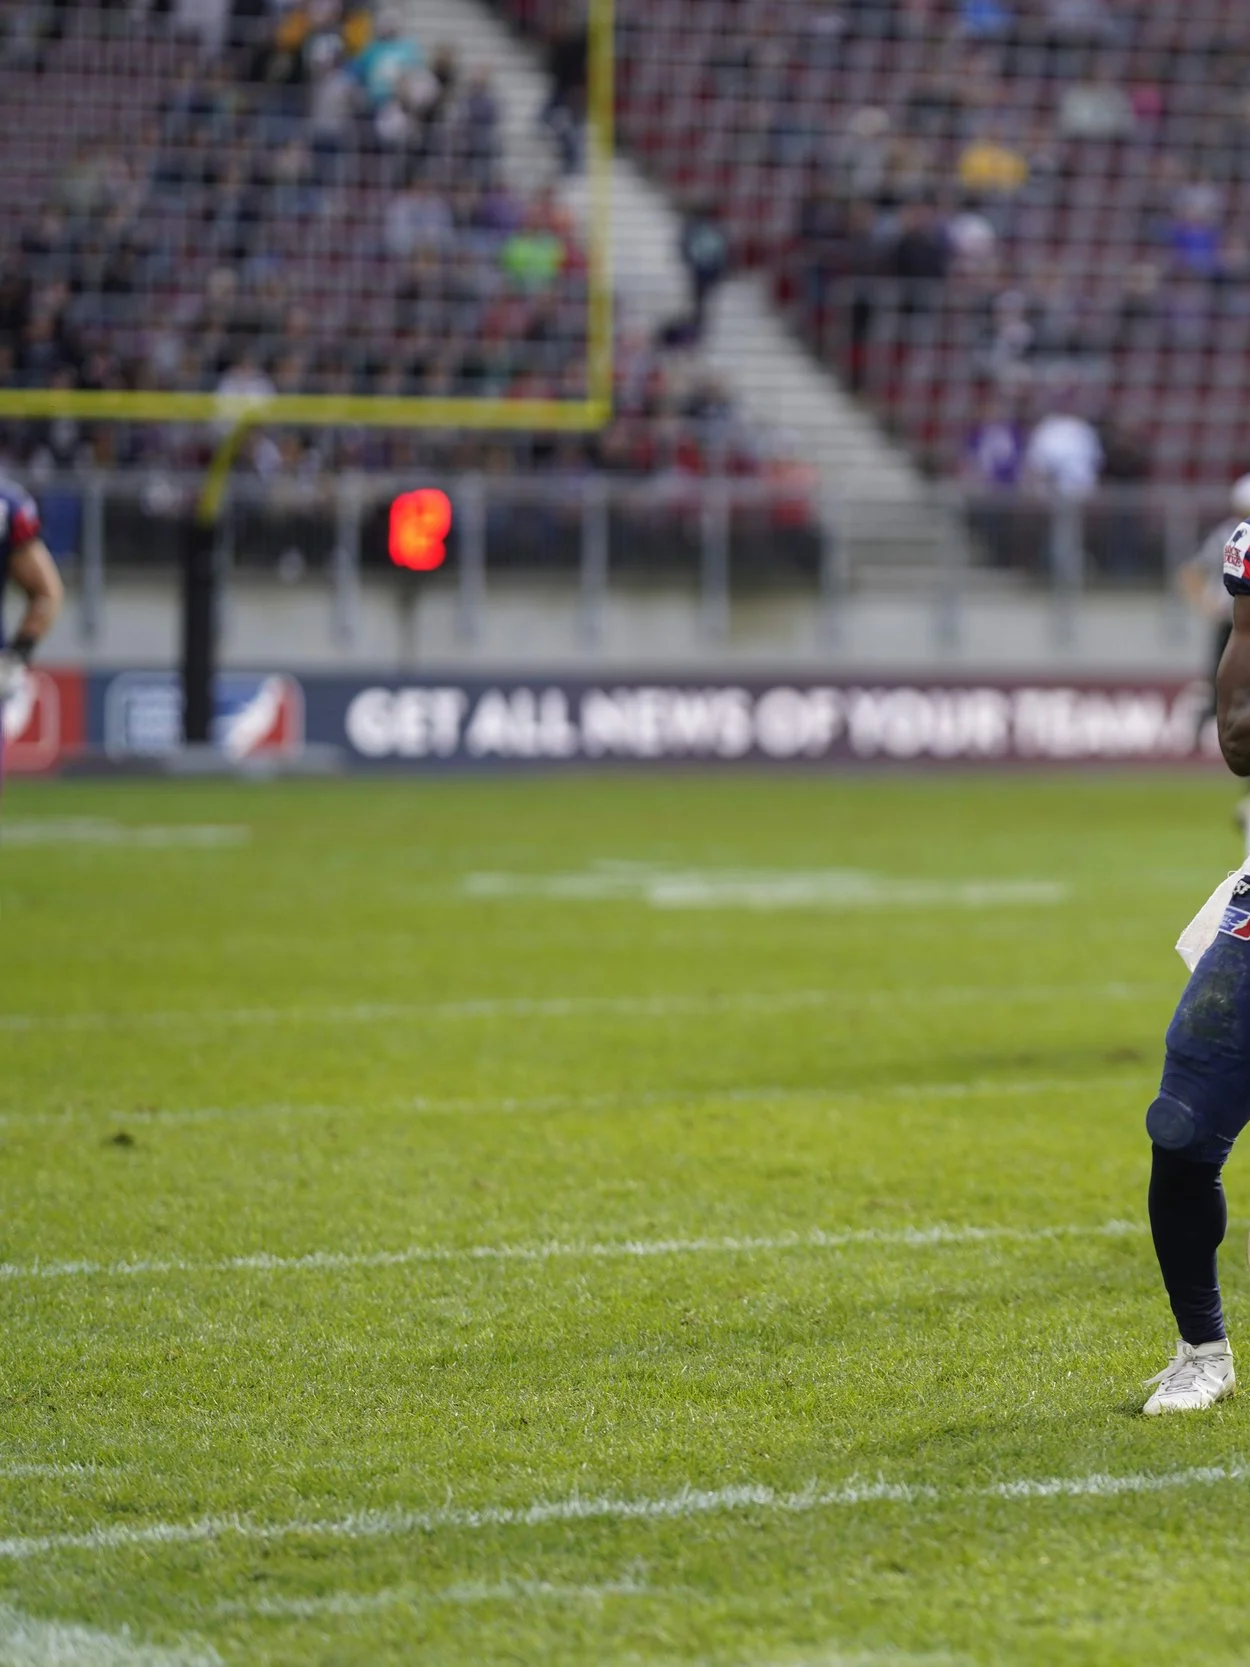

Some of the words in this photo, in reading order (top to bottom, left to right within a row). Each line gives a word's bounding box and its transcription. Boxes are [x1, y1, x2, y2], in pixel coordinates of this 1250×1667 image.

[345, 686, 467, 758] GET
[464, 686, 579, 758] ALL
[580, 686, 752, 758] NEWS
[753, 686, 846, 758] OF
